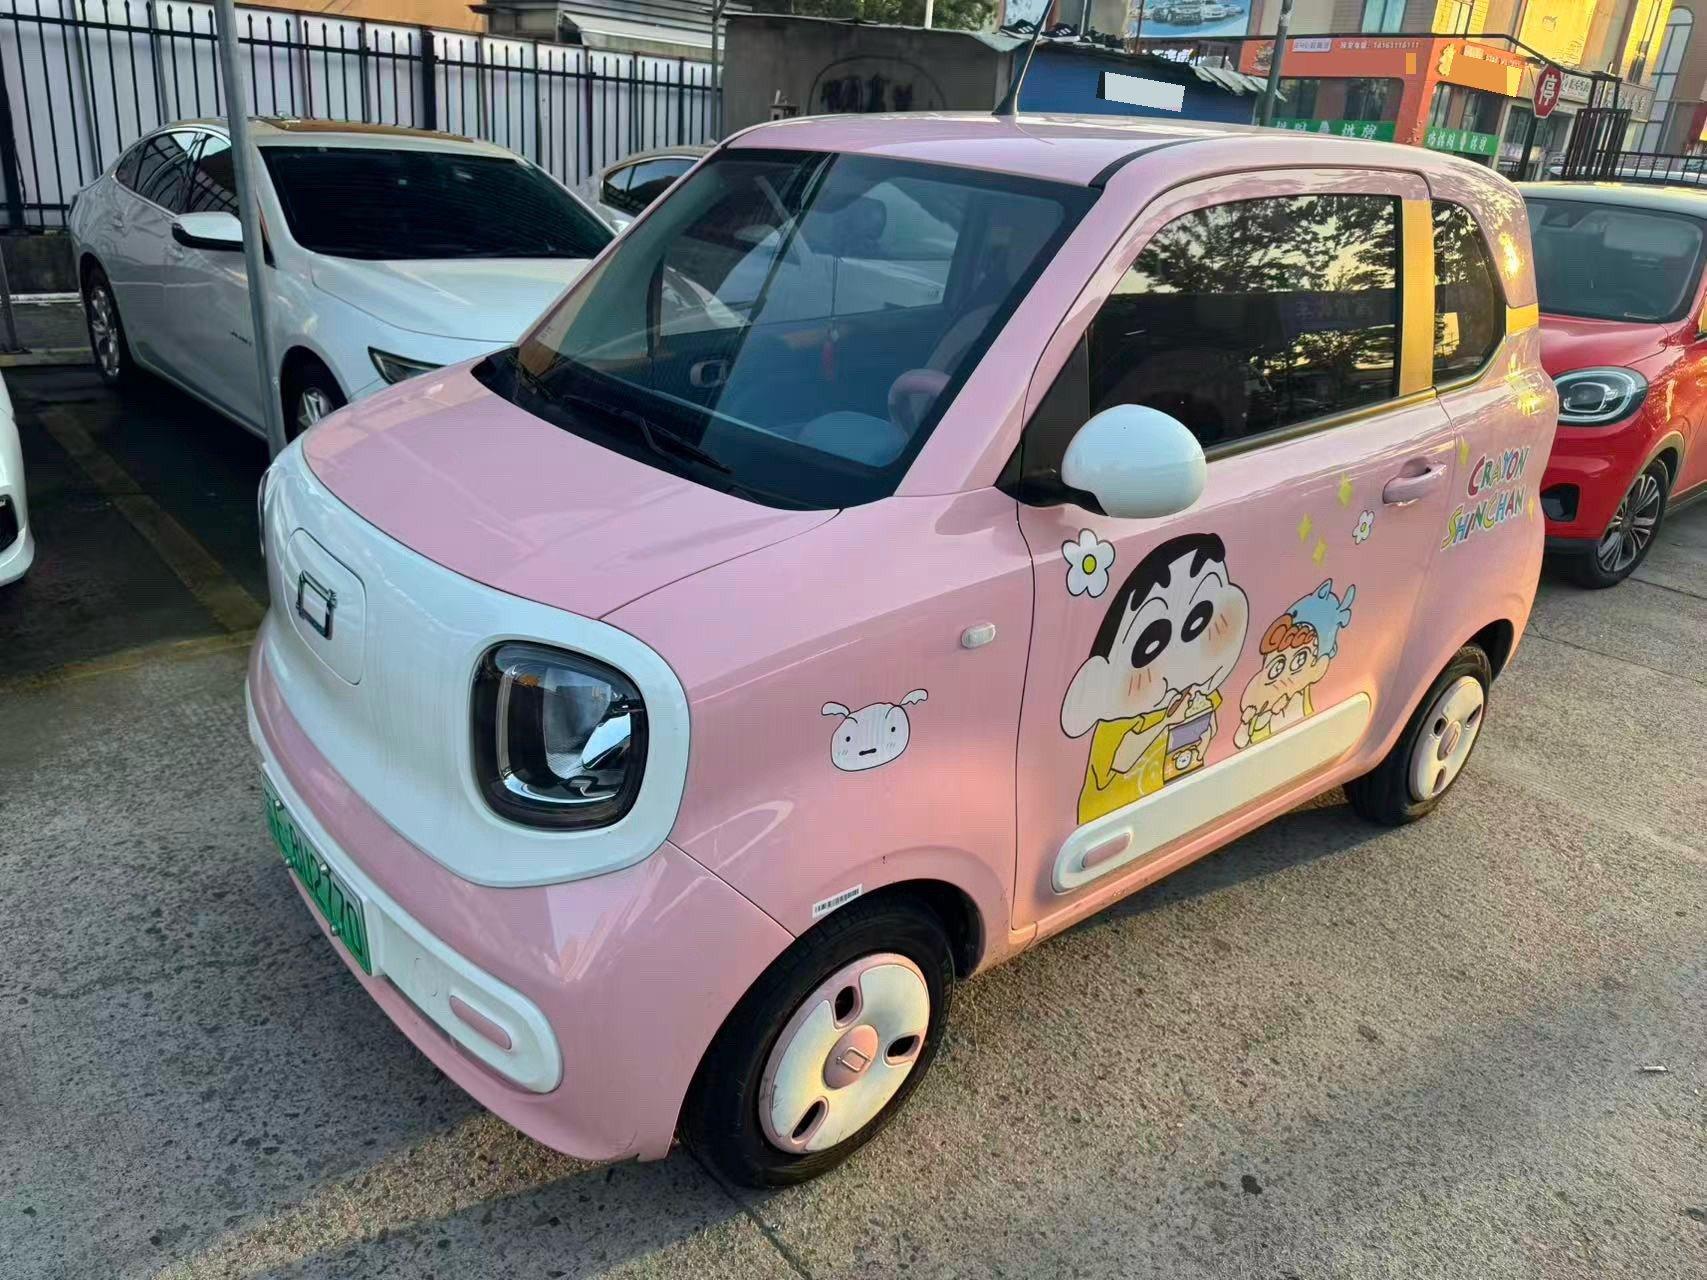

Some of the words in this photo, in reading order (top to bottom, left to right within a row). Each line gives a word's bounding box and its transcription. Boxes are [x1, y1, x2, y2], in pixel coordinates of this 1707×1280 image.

[1539, 74, 1558, 106] 停
[1467, 447, 1530, 496] CRAYON
[1440, 486, 1526, 550] SHINCHAN
